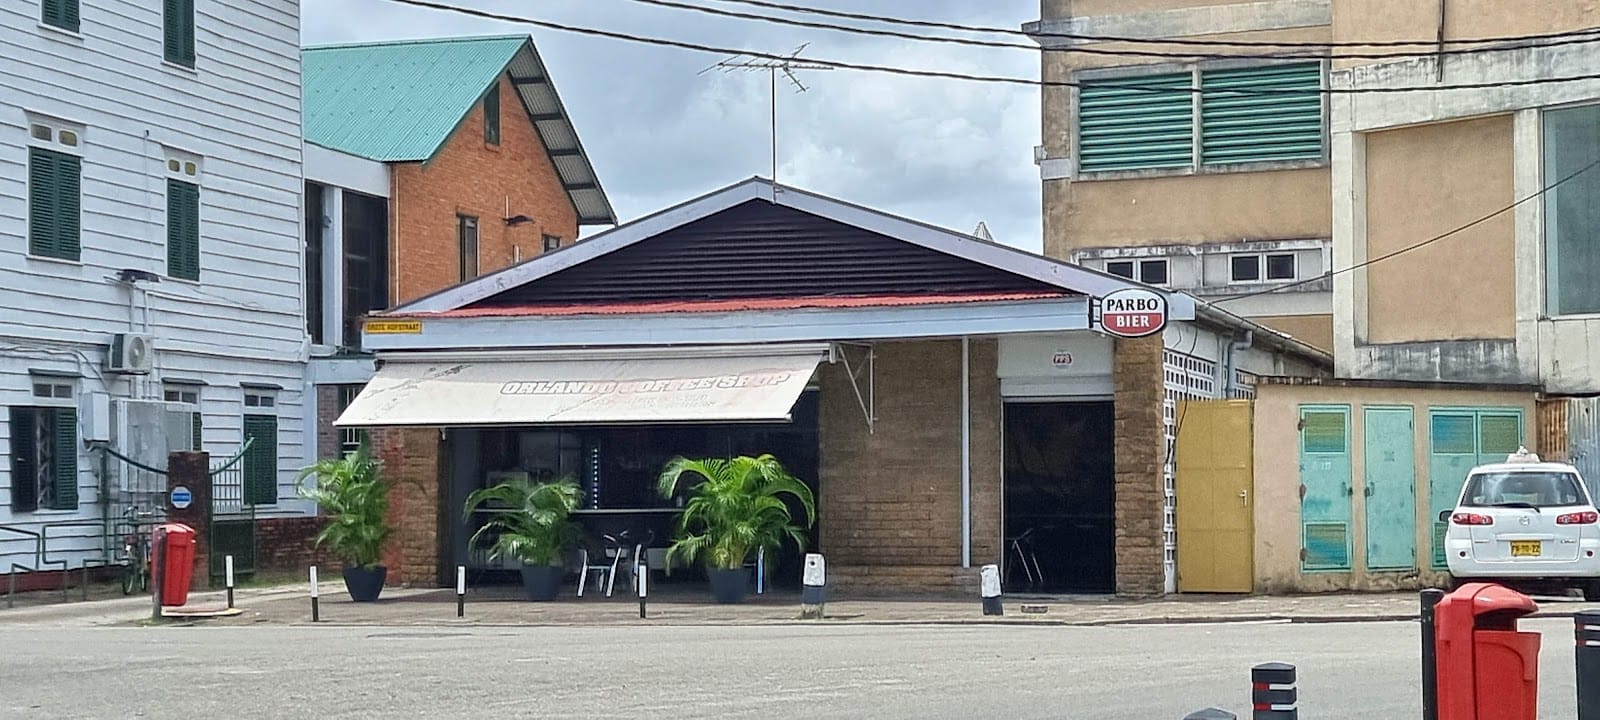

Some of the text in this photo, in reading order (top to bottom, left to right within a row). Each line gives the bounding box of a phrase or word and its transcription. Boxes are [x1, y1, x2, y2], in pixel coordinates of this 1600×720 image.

[1107, 298, 1158, 311] PARBO
[1116, 315, 1150, 328] BIER
[500, 371, 791, 395] ORLANDO COFFEE SHOP
